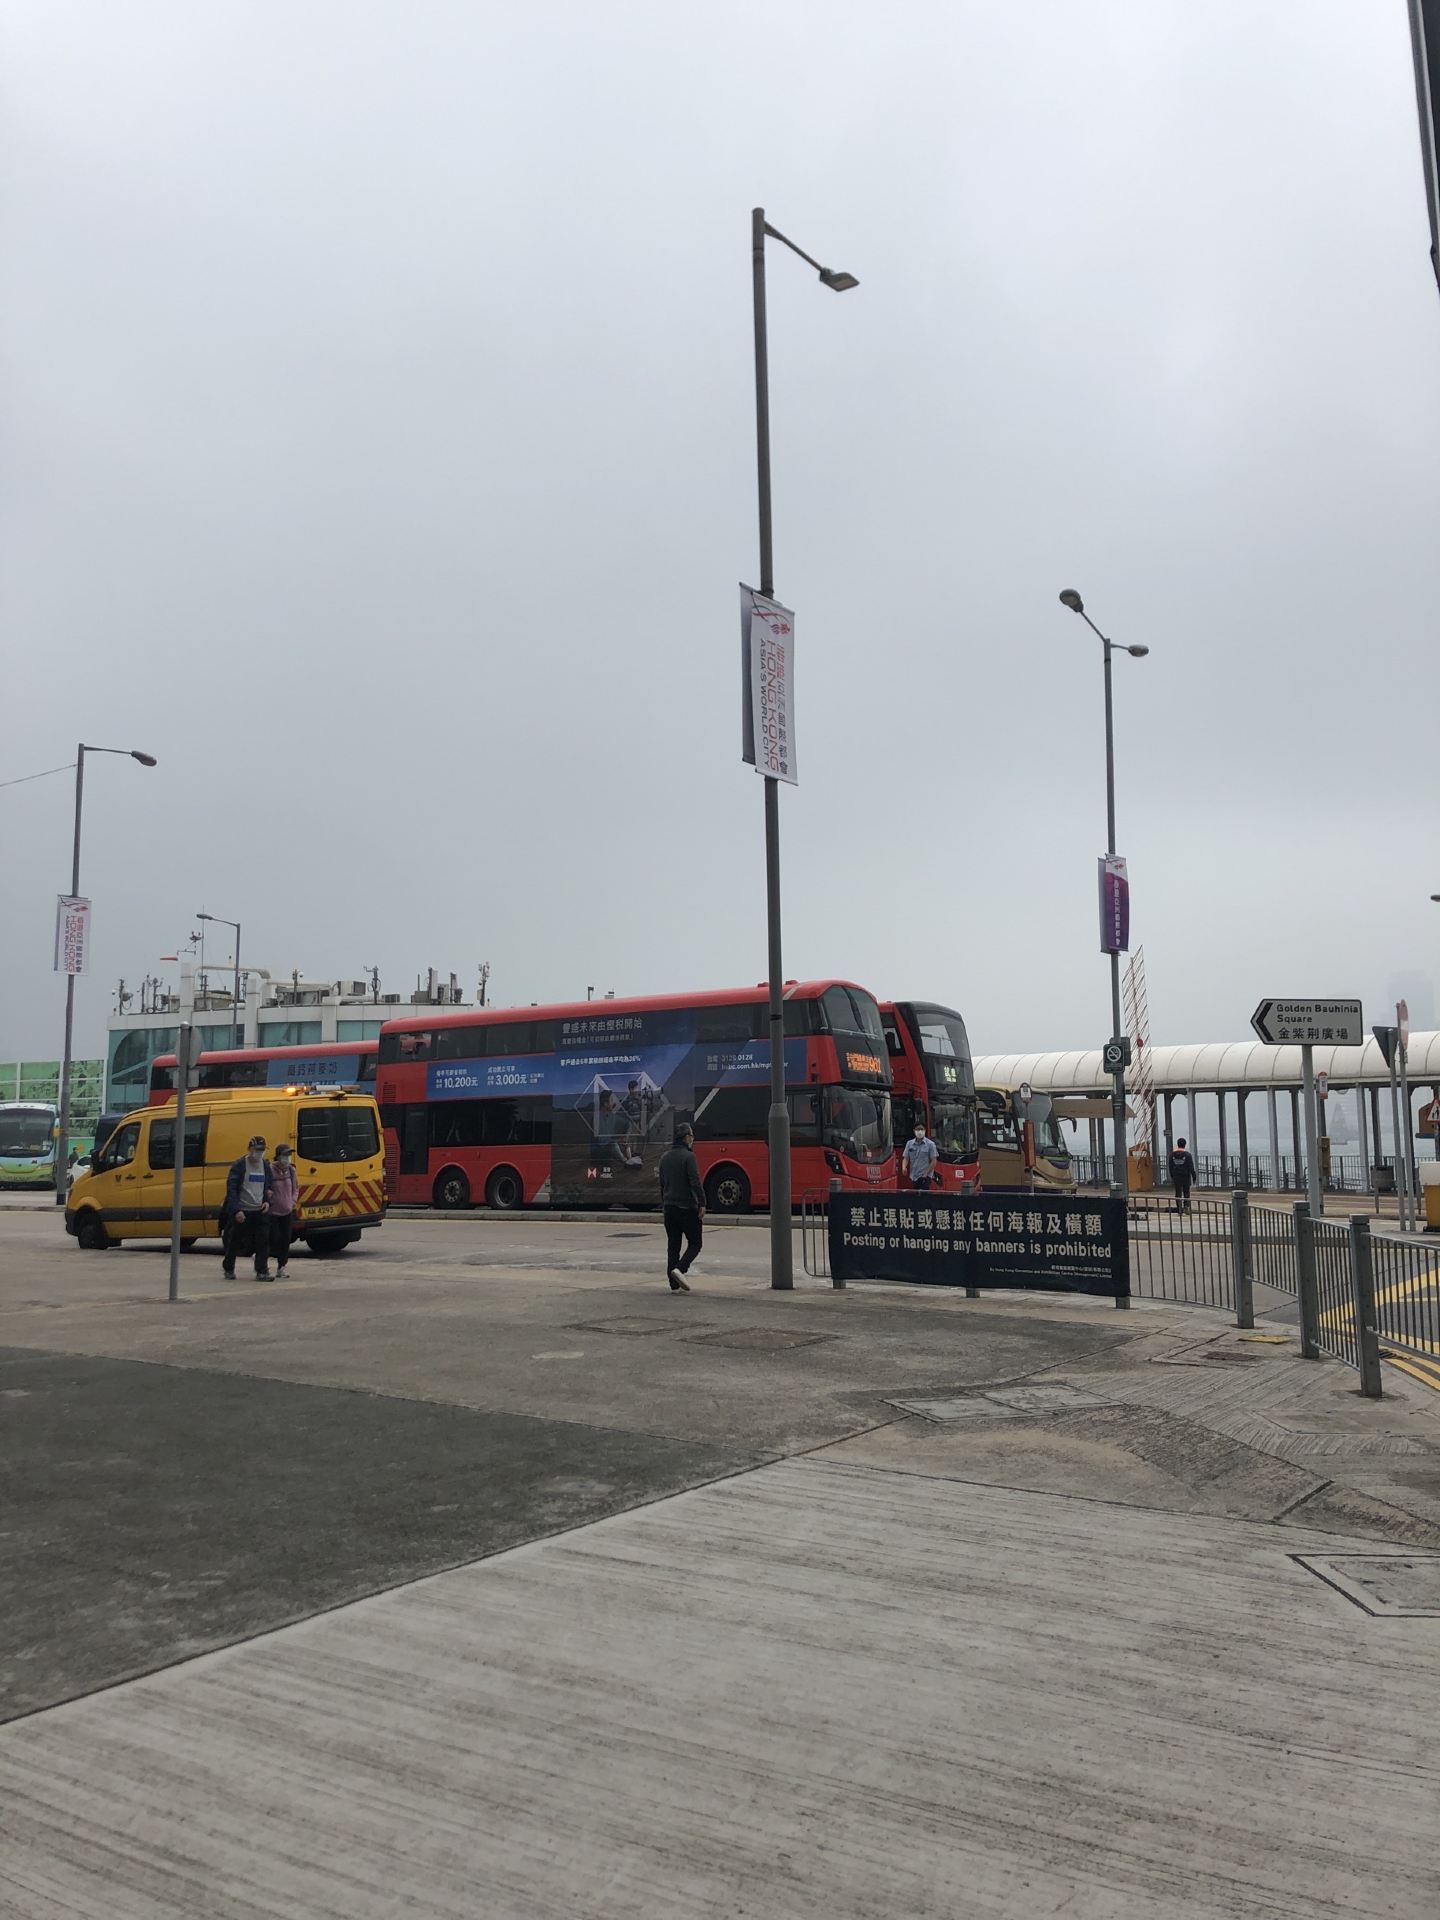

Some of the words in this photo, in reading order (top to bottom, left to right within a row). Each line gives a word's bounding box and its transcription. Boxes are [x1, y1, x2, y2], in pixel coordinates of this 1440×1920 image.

[766, 640, 777, 703] HONG
[768, 708, 779, 772] KONG
[1276, 1004, 1312, 1013] Golden
[1314, 1004, 1359, 1013] Bauhinia
[1276, 1014, 1313, 1024] Square
[444, 1076, 479, 1089] 10,200元
[495, 1073, 528, 1086] 3,000元
[850, 1207, 1103, 1236] 禁止張貼或懸掛任何海報及橫額
[843, 1231, 886, 1250] Posting
[889, 1236, 901, 1248] or
[903, 1233, 949, 1252] hanging
[953, 1240, 972, 1254] any
[976, 1237, 1026, 1254] banners
[1030, 1240, 1041, 1254] is
[1045, 1241, 1112, 1259] prohibited
